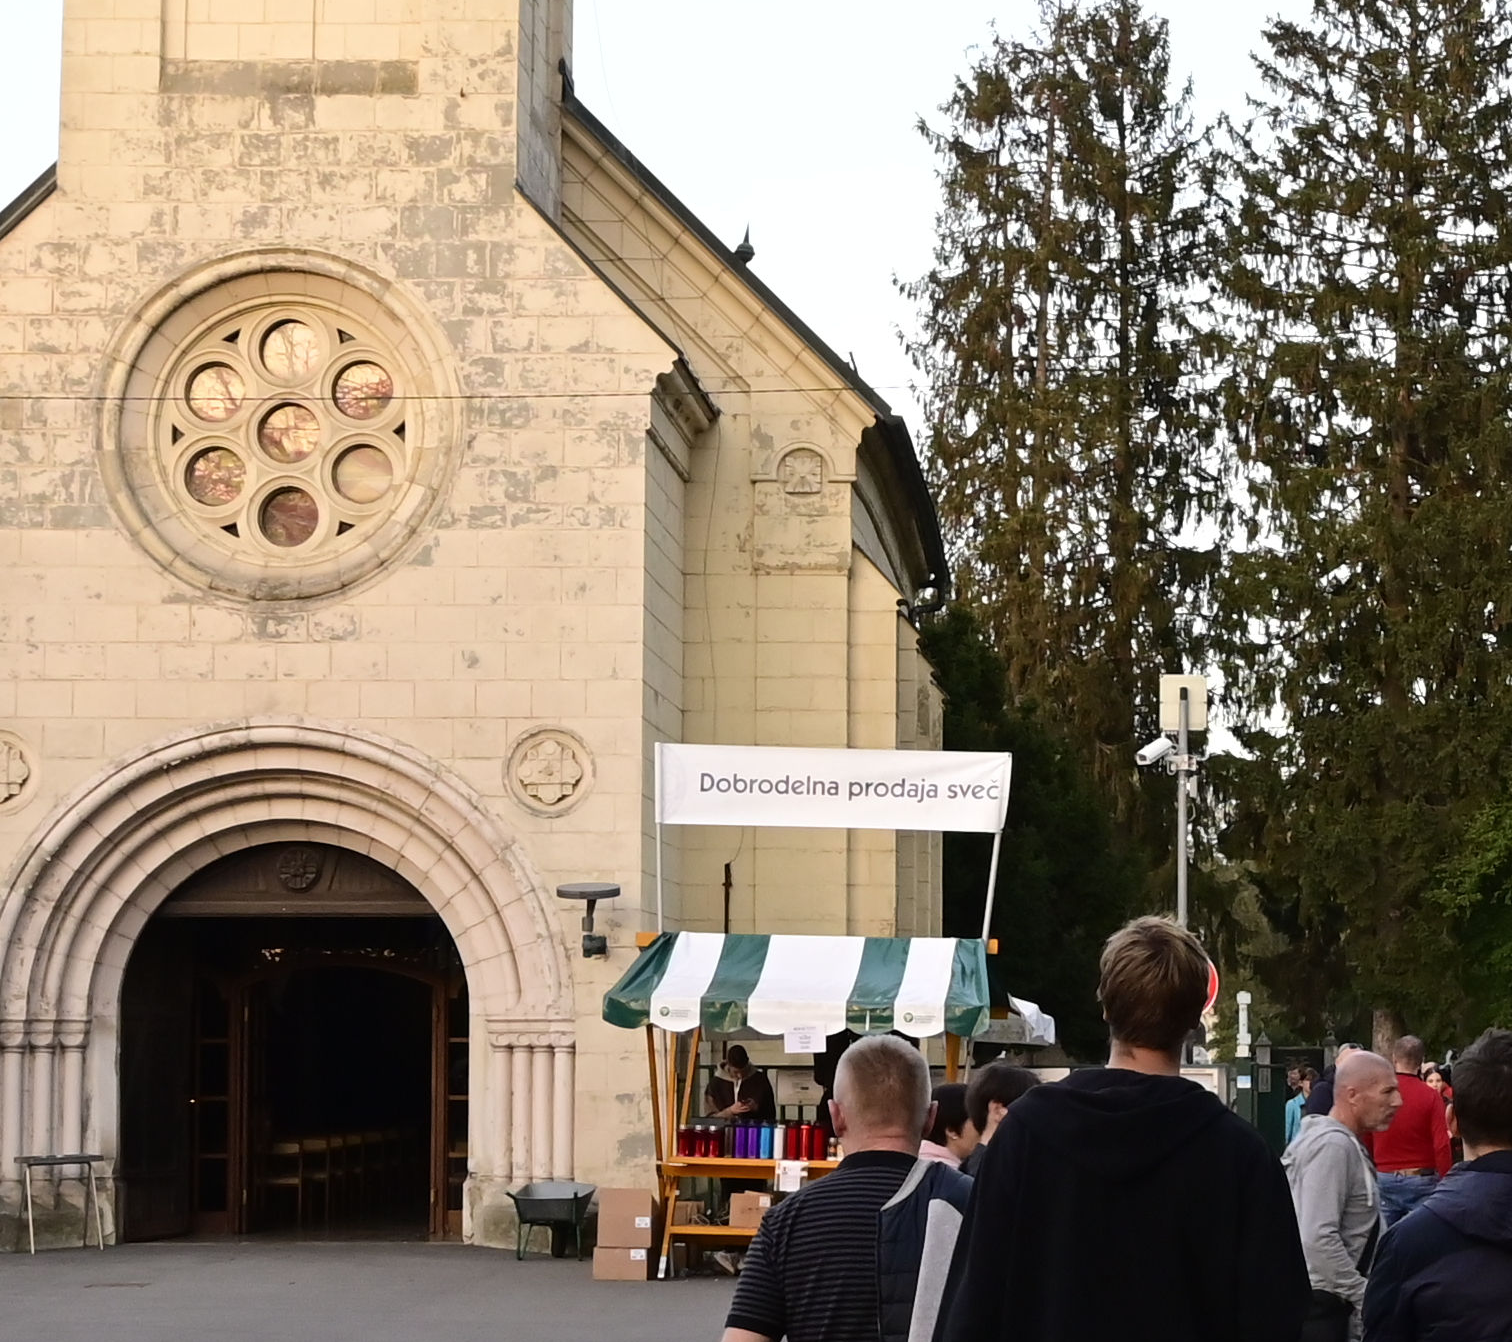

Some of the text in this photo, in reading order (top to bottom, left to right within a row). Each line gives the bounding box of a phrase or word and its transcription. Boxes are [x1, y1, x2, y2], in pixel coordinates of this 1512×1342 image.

[700, 772, 1000, 803] Dobrodelna prodaja sveč
